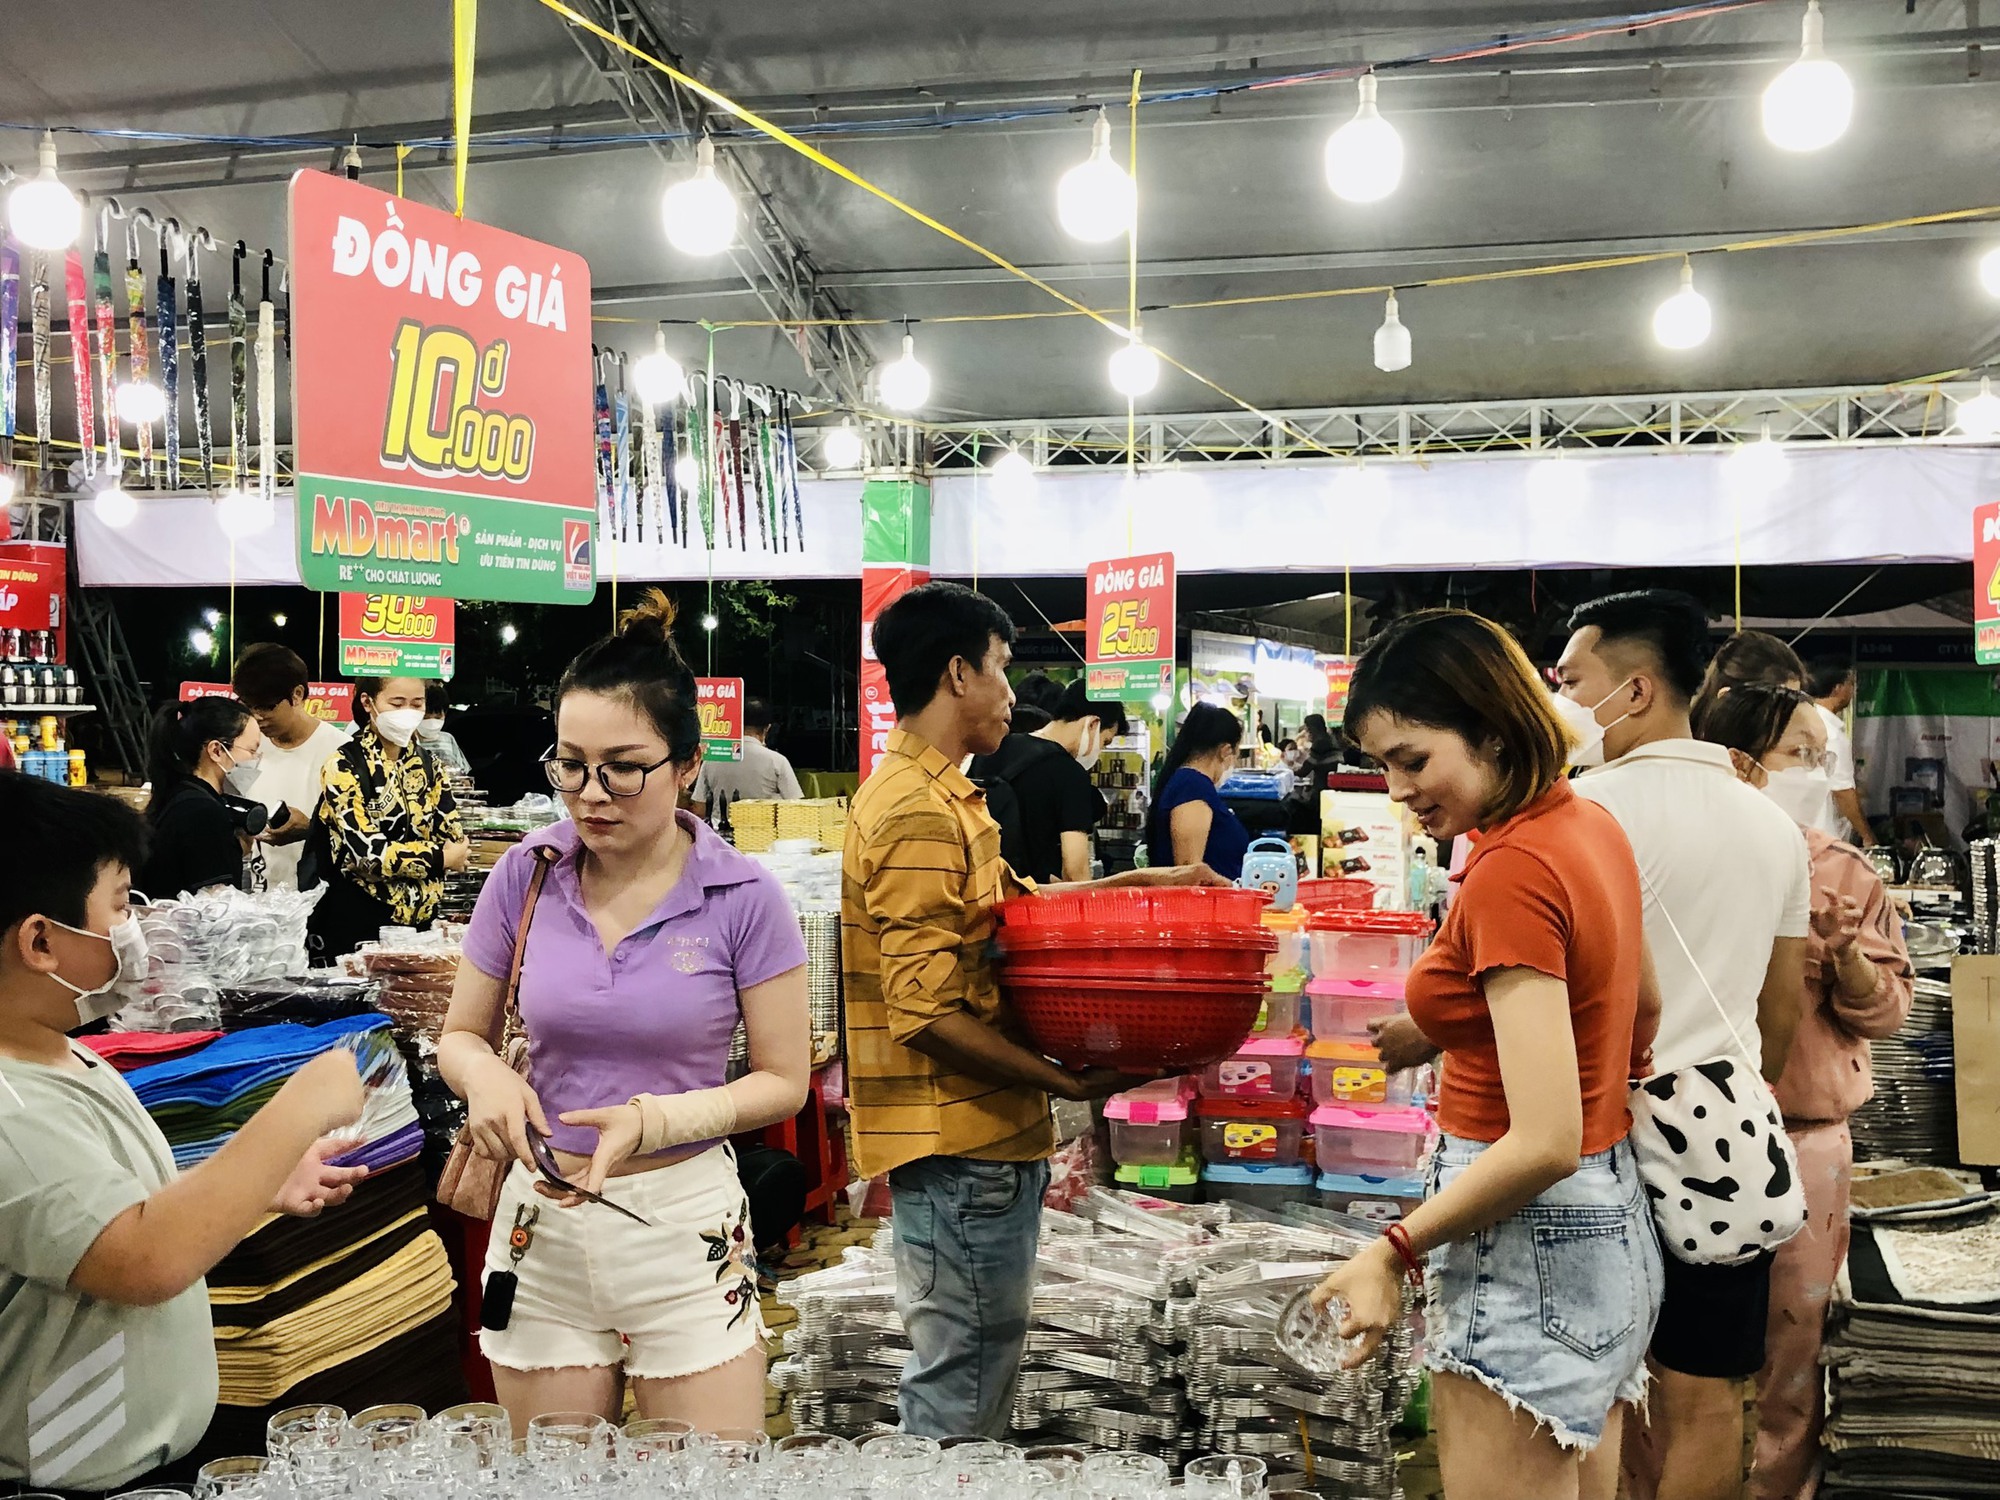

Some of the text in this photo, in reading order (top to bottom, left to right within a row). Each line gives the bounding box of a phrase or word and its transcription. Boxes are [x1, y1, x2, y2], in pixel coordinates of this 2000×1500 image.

[332, 200, 567, 332] ĐỒNG GIÁ
[311, 494, 460, 564] MDmart
[365, 569, 384, 583] CHO
[1094, 558, 1165, 595] ĐỒNG GIÁ
[328, 685, 349, 696] GIÁ
[716, 681, 736, 698] GIÁ
